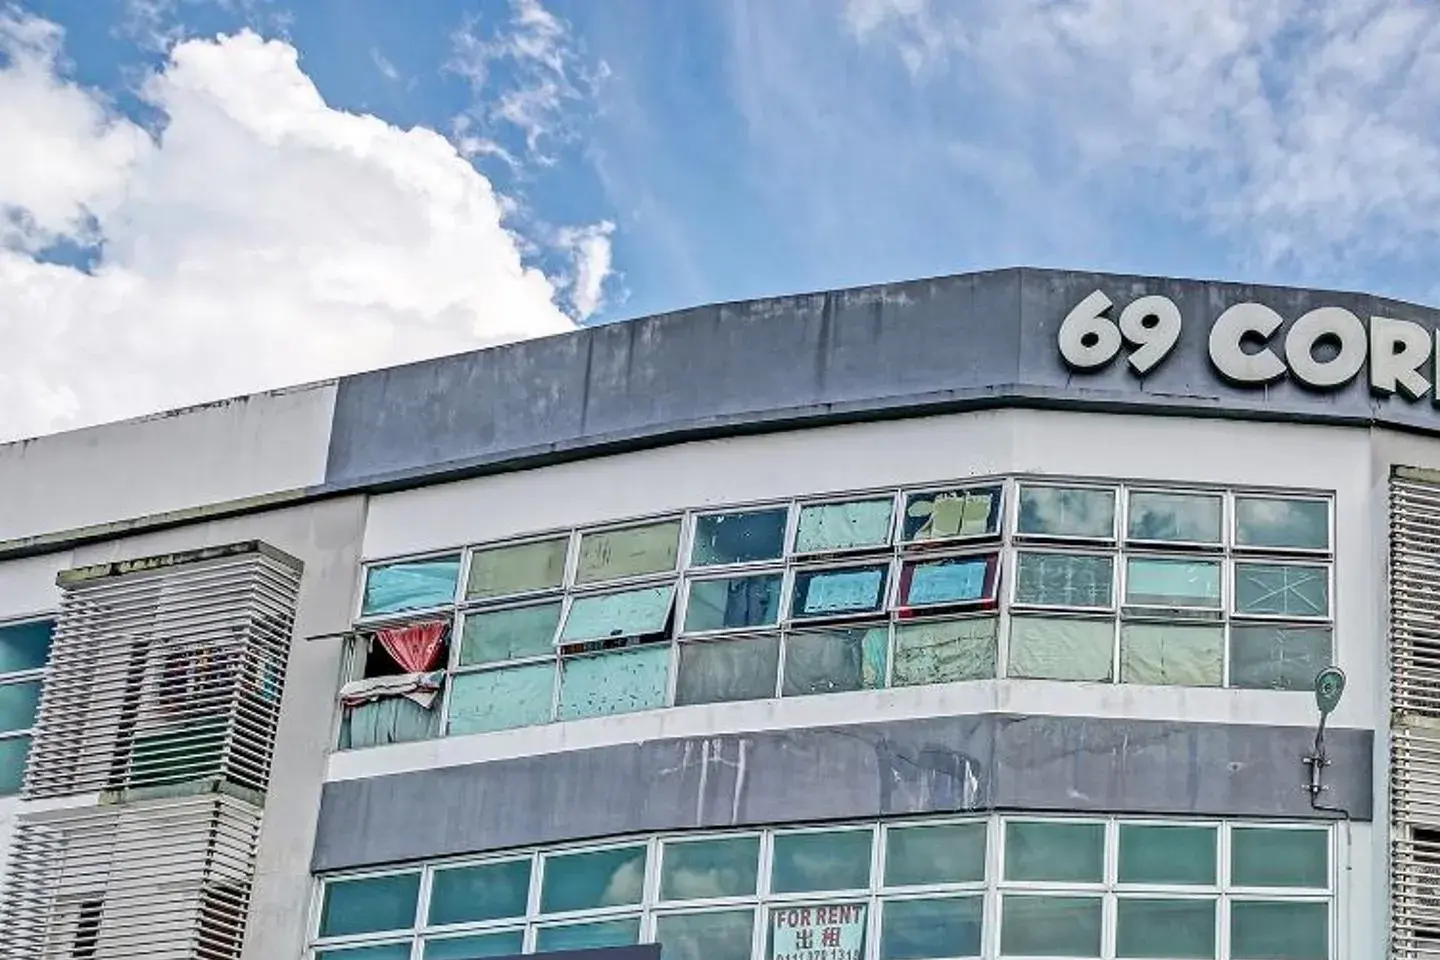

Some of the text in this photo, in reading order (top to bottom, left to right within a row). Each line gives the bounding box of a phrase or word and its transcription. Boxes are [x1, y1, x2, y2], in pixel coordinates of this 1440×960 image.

[1058, 289, 1183, 376] 69
[777, 904, 863, 928] FOR RENT
[796, 926, 841, 949] 出租
